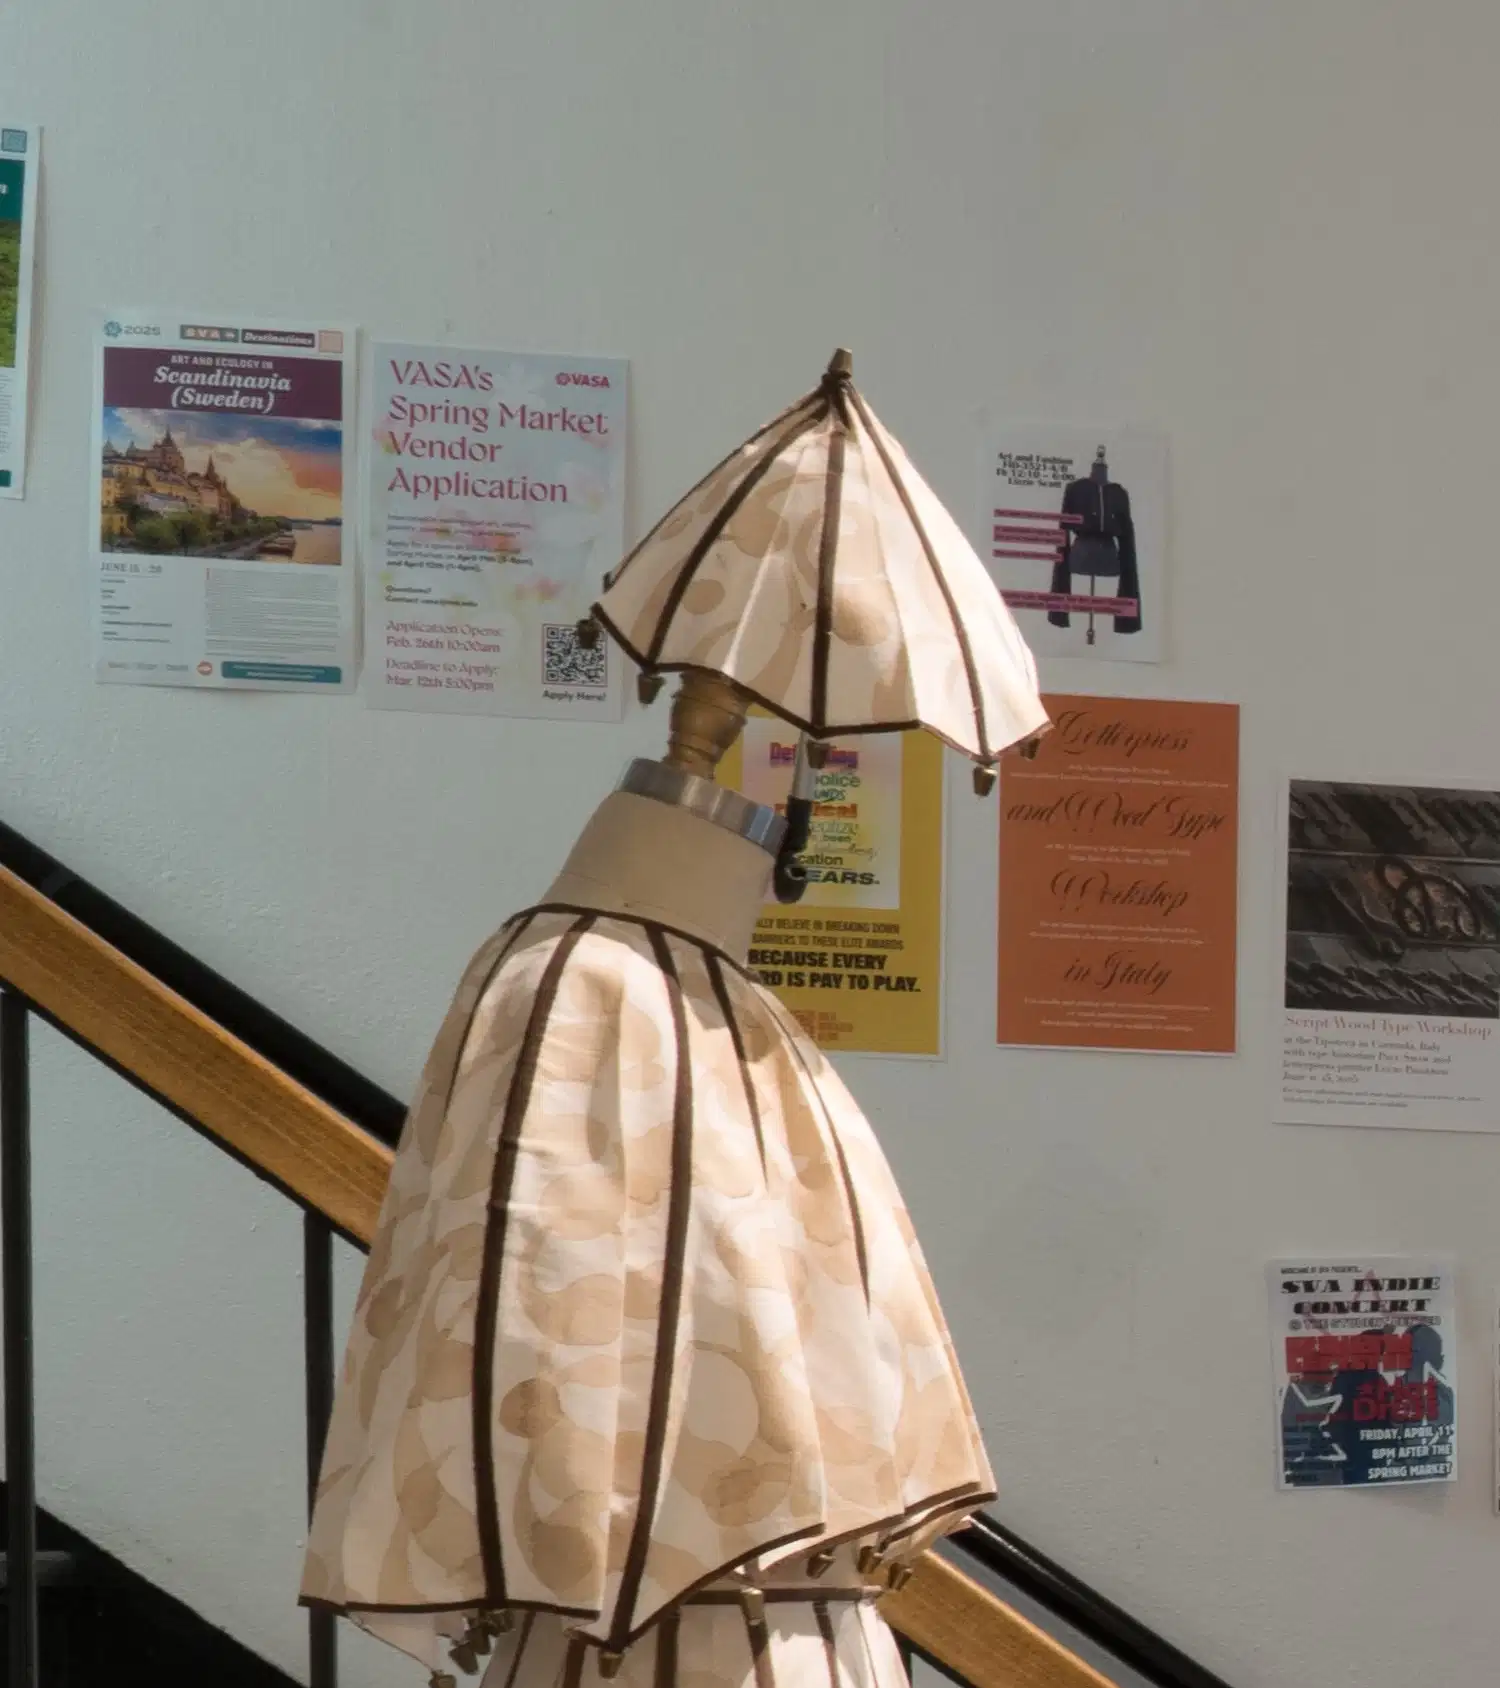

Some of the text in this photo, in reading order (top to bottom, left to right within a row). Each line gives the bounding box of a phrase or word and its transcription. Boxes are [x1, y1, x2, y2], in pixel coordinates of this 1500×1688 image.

[153, 366, 292, 392] Scandinavia
[569, 374, 611, 388] VASA
[171, 387, 275, 414] (Sweden)
[388, 394, 609, 435] Spring Market
[388, 430, 504, 463] Vendor
[387, 466, 568, 503] Application
[1055, 710, 1194, 758] Letterpress
[1006, 791, 1229, 841] and Wood Type
[1050, 868, 1190, 917] Workshop
[748, 949, 888, 970] BECAUSE EVERY
[787, 972, 805, 988] IS
[809, 972, 844, 989] PAY
[848, 974, 869, 990] TO
[873, 975, 921, 993] PLAY.
[1063, 950, 1173, 996] in Italy
[1286, 1015, 1492, 1041] Script Wood Type Workshop
[1281, 1276, 1440, 1294] SVA INDIE
[1293, 1298, 1431, 1315] CONCERT
[1372, 1444, 1453, 1460] 8PM AFTER THE
[1367, 1462, 1453, 1480] SPRING MARKET
